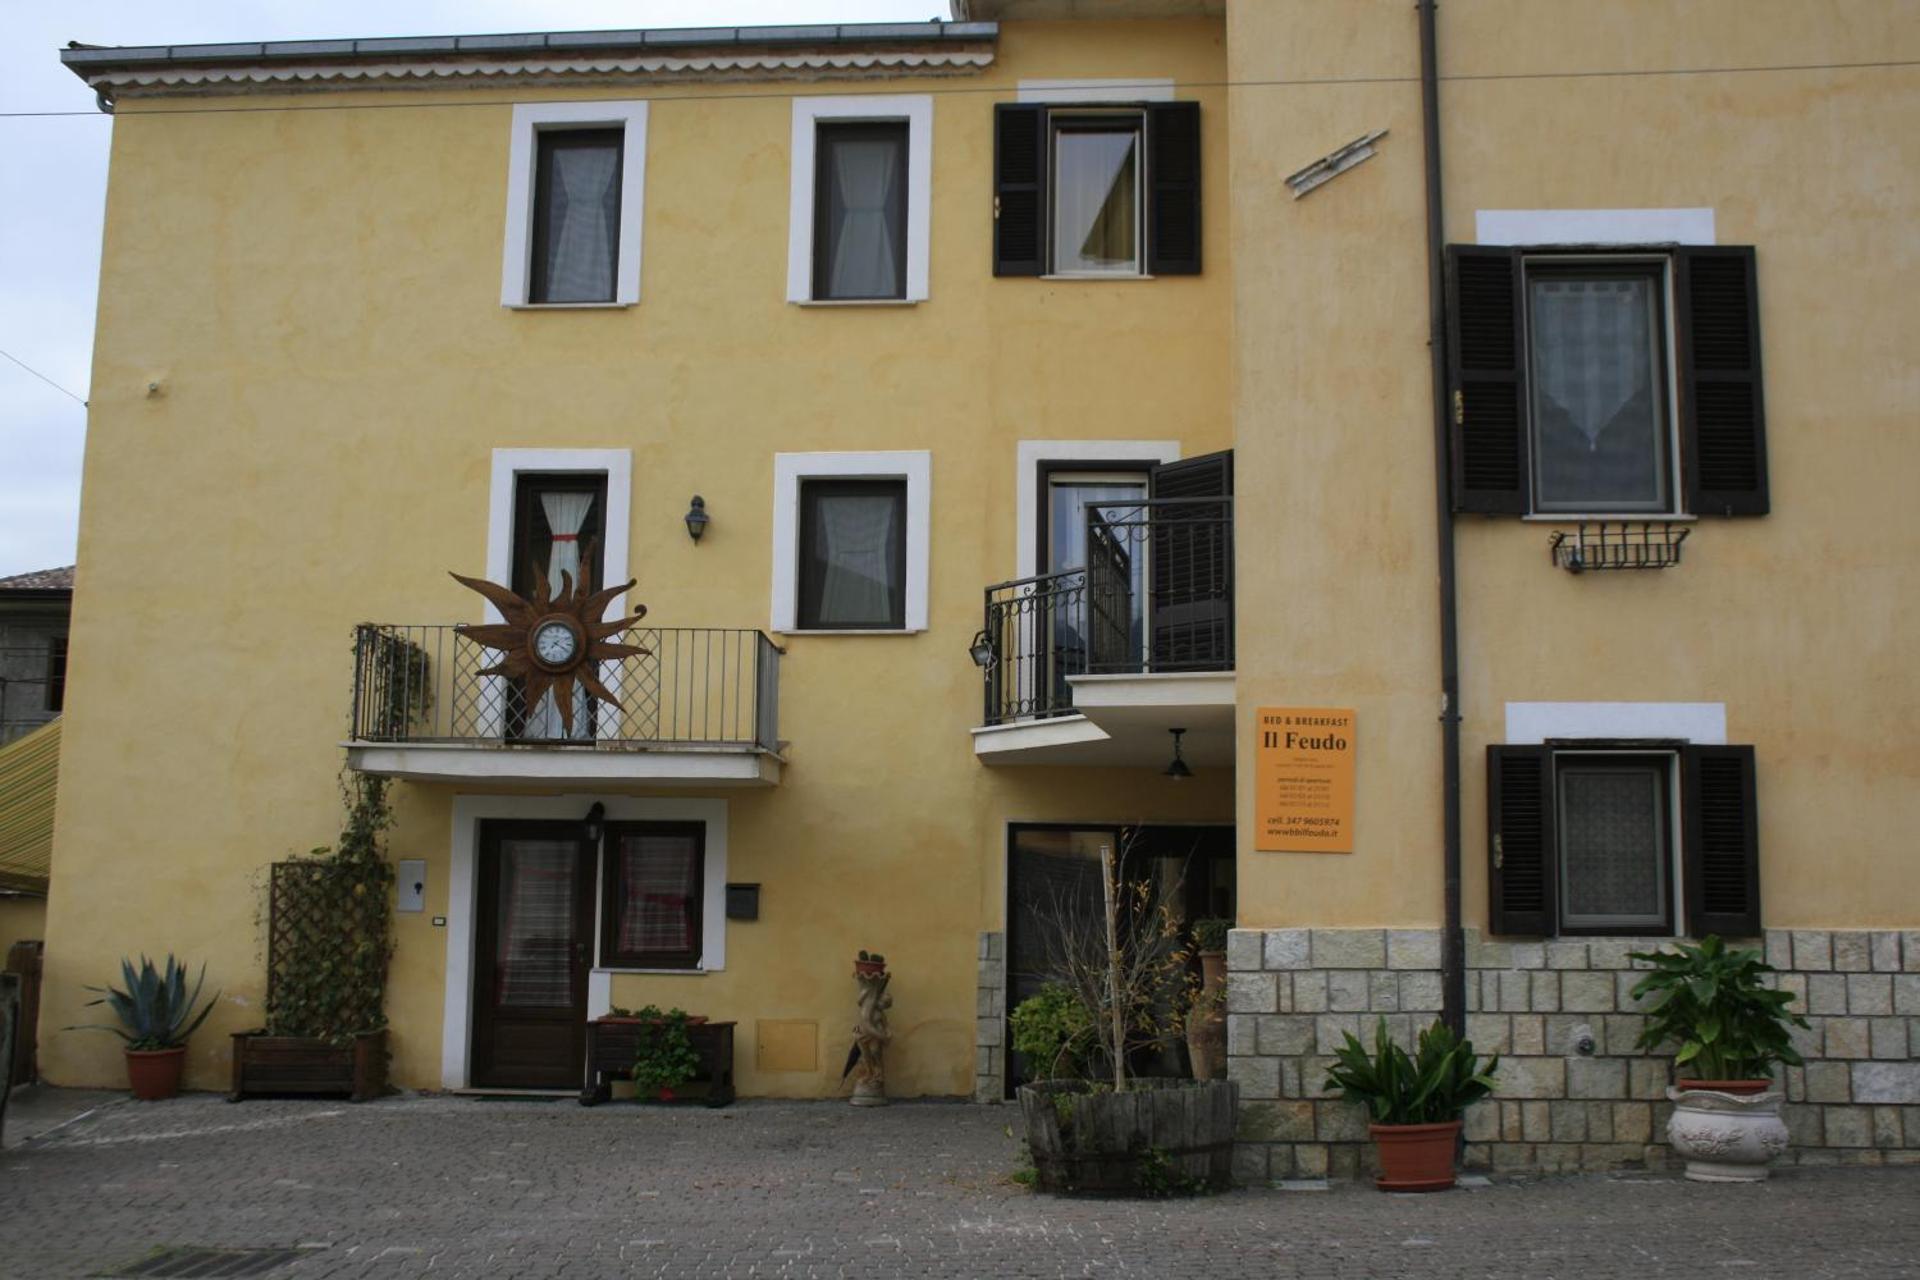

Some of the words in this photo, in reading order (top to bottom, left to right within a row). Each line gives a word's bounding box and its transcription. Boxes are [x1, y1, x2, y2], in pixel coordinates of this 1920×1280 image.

[1264, 716, 1281, 725] BED
[1285, 716, 1292, 725] &
[1295, 717, 1348, 727] BREAKFAST
[1264, 731, 1277, 748] Il
[1285, 731, 1347, 750] Feudo
